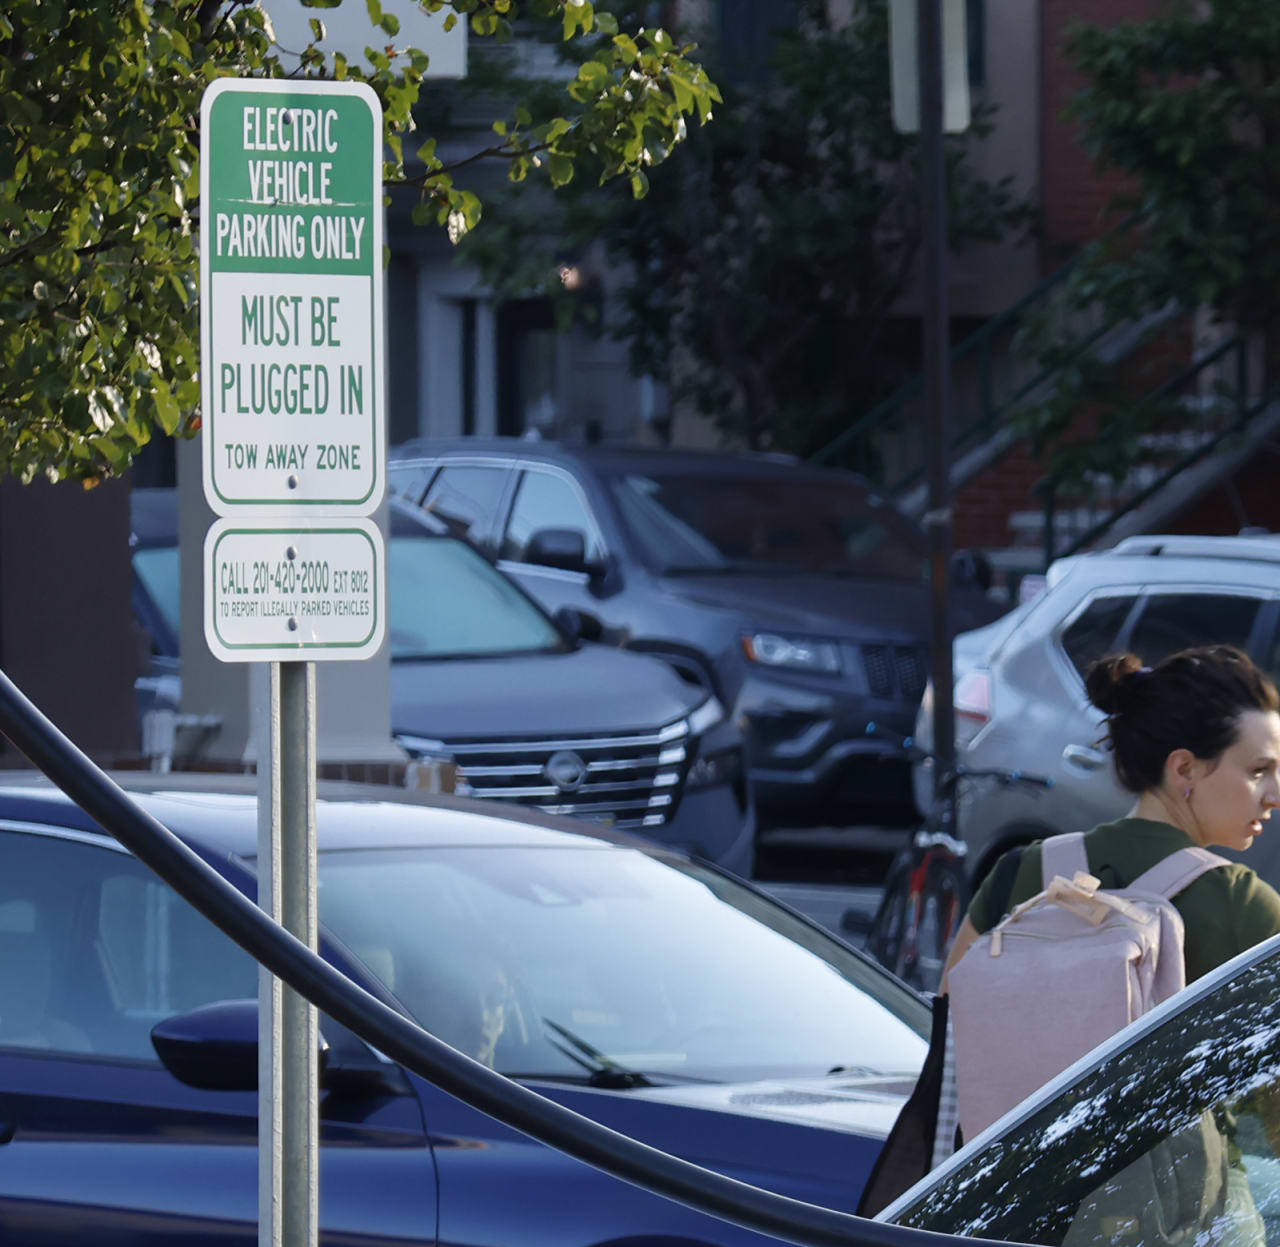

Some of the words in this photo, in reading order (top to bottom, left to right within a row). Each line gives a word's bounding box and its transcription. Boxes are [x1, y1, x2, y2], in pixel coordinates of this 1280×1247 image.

[243, 107, 338, 153] ELECTRIC
[248, 160, 333, 205] VEHICLE
[216, 213, 305, 259] PARKING
[311, 215, 365, 260] ONLY
[241, 295, 303, 346] MUST
[311, 296, 341, 347] BE
[221, 363, 329, 415] PLUGGED
[340, 365, 363, 415] IN
[225, 443, 258, 469] TOW
[265, 444, 309, 469] AWAY
[316, 444, 361, 470] ZONE
[220, 561, 249, 594] CALL
[253, 560, 329, 594] 201-420-2000
[333, 570, 348, 593] EXT
[351, 570, 368, 593] 8012
[220, 601, 229, 617] TO
[231, 601, 258, 617] REPORT
[260, 600, 298, 617] ILLEGALLY
[301, 600, 332, 616] PARKED
[333, 599, 369, 616] VEHICLES
